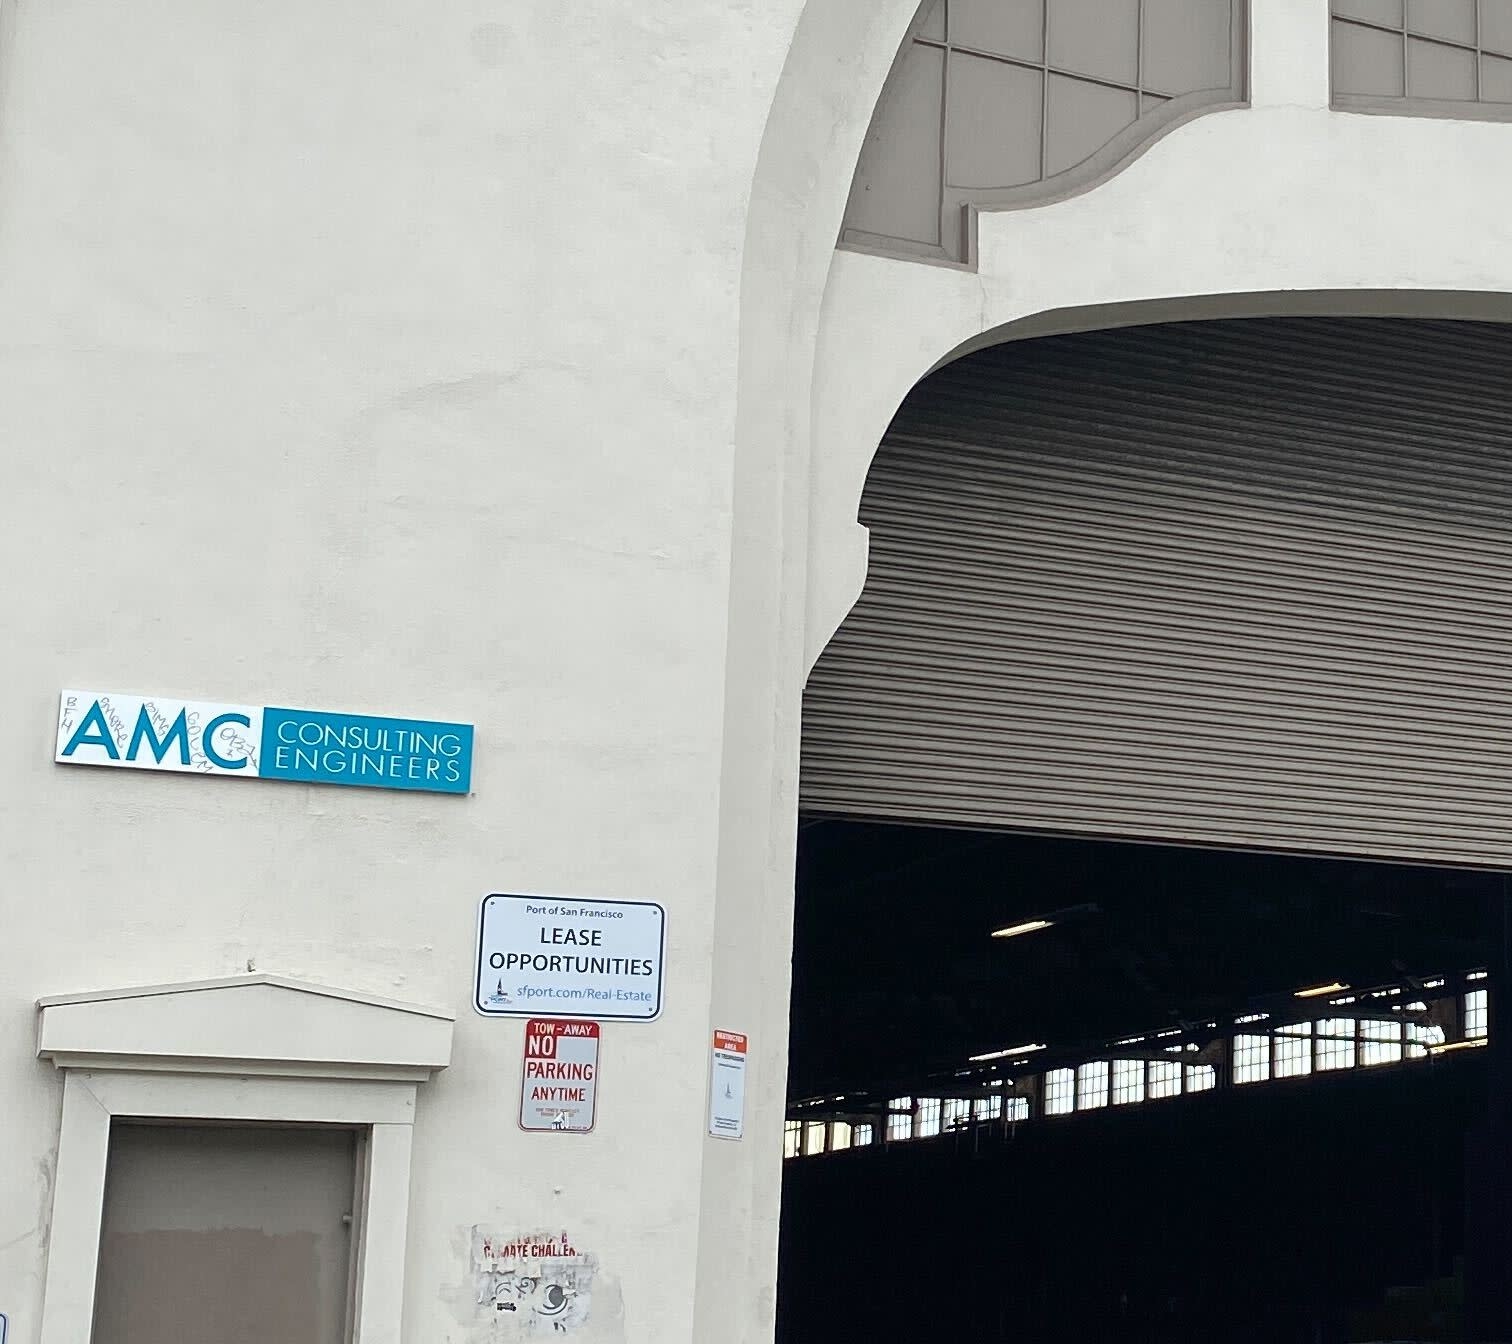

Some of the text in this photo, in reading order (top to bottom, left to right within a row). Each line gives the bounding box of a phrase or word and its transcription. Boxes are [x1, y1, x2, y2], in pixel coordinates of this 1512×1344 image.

[61, 699, 250, 770] AMC
[277, 720, 462, 757] CONSULTING
[275, 746, 460, 782] ENGINEERS
[526, 905, 624, 919] Port of San Francisco
[540, 927, 602, 947] LEASE
[489, 952, 653, 977] OPPORTUNITIES
[517, 984, 652, 1002] sfport.com/Real-Estate
[528, 1035, 553, 1056] NO
[527, 1062, 593, 1081] PARKING
[531, 1086, 586, 1102] ANYTIME
